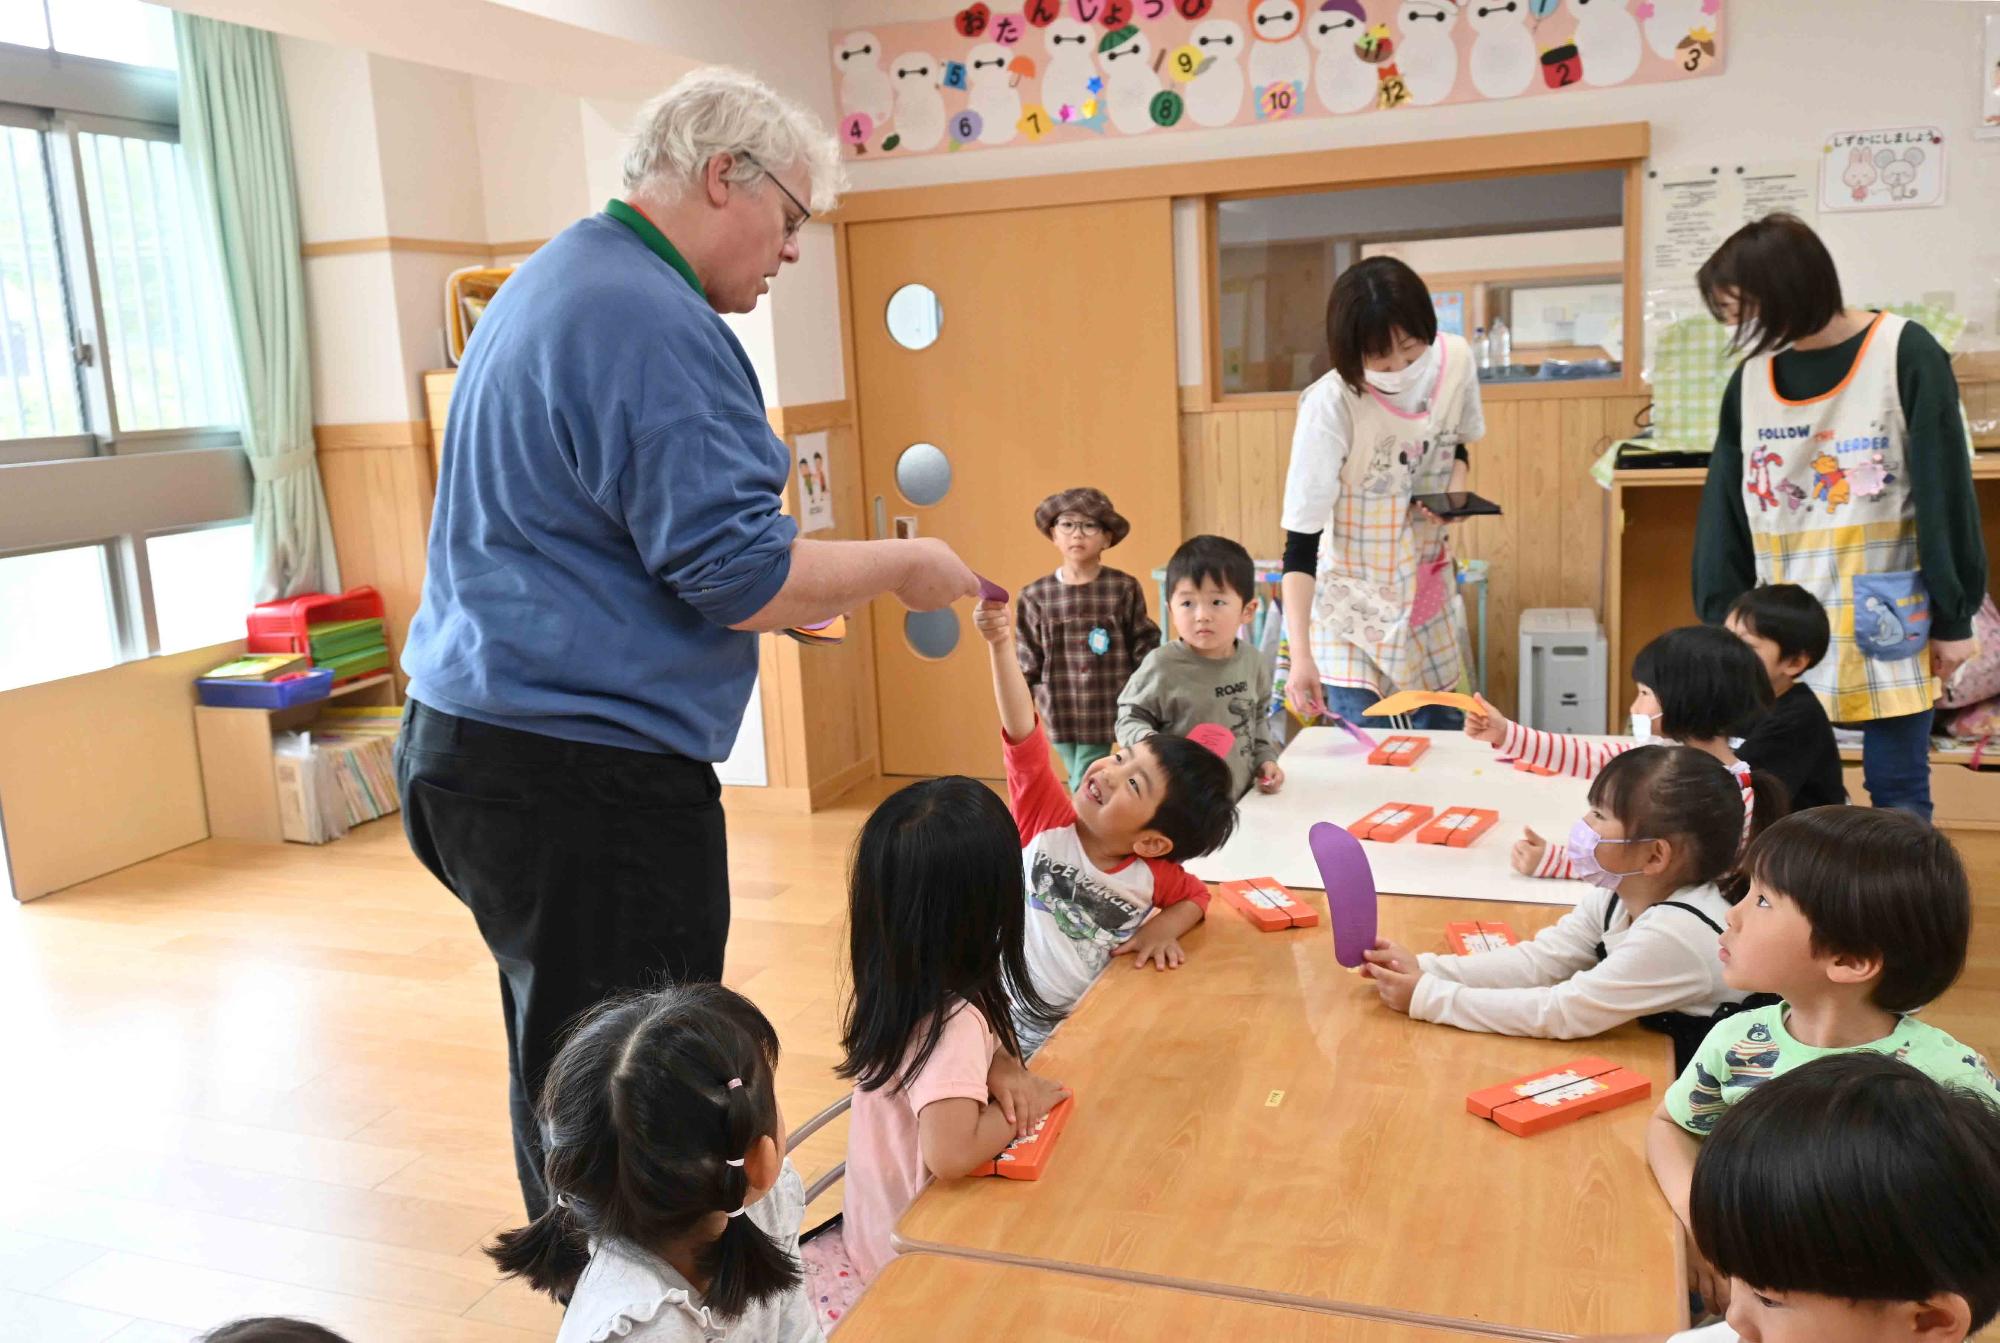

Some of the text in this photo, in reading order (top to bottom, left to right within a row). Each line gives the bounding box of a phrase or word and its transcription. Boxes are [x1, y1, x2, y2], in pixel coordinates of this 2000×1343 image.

[1178, 53, 1192, 73] 9
[1684, 49, 1701, 71] 3
[950, 63, 961, 86] 5
[1556, 63, 1575, 86] 2
[1269, 91, 1290, 110] 10
[1382, 81, 1405, 102] 12
[1159, 98, 1173, 119] 8
[850, 120, 863, 139] 4
[959, 117, 972, 137] 6
[1027, 113, 1041, 134] 7
[1758, 425, 1810, 441] FOLLOW
[1836, 436, 1890, 453] LEADER
